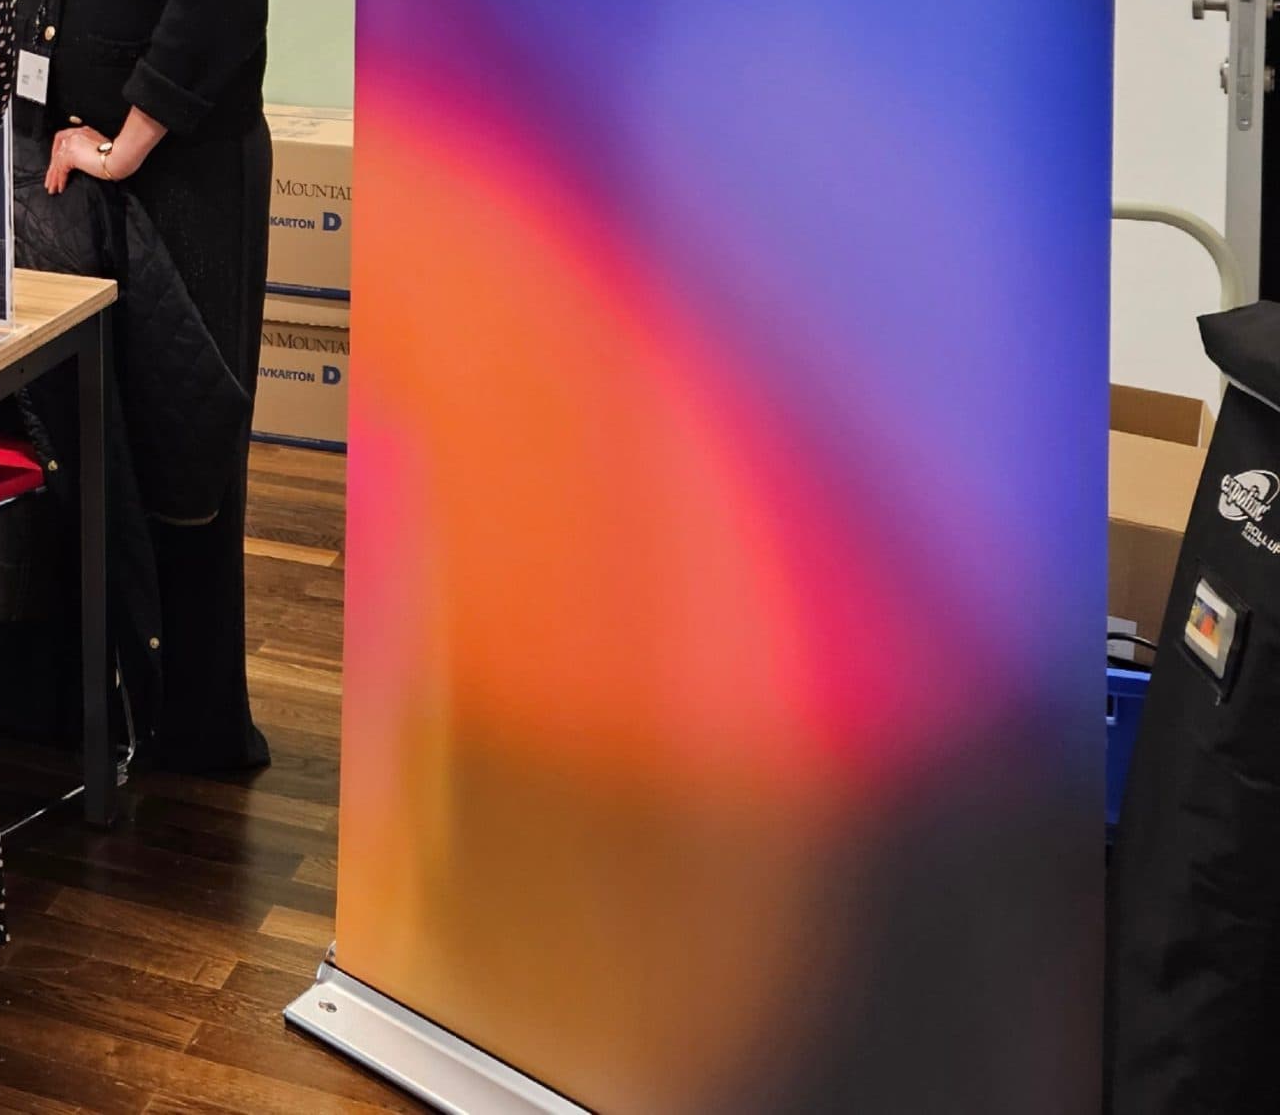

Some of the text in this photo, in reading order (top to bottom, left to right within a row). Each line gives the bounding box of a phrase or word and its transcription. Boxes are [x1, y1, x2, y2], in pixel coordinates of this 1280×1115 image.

[322, 211, 342, 232] D
[322, 365, 341, 386] D
[1244, 521, 1268, 546] ROLL
